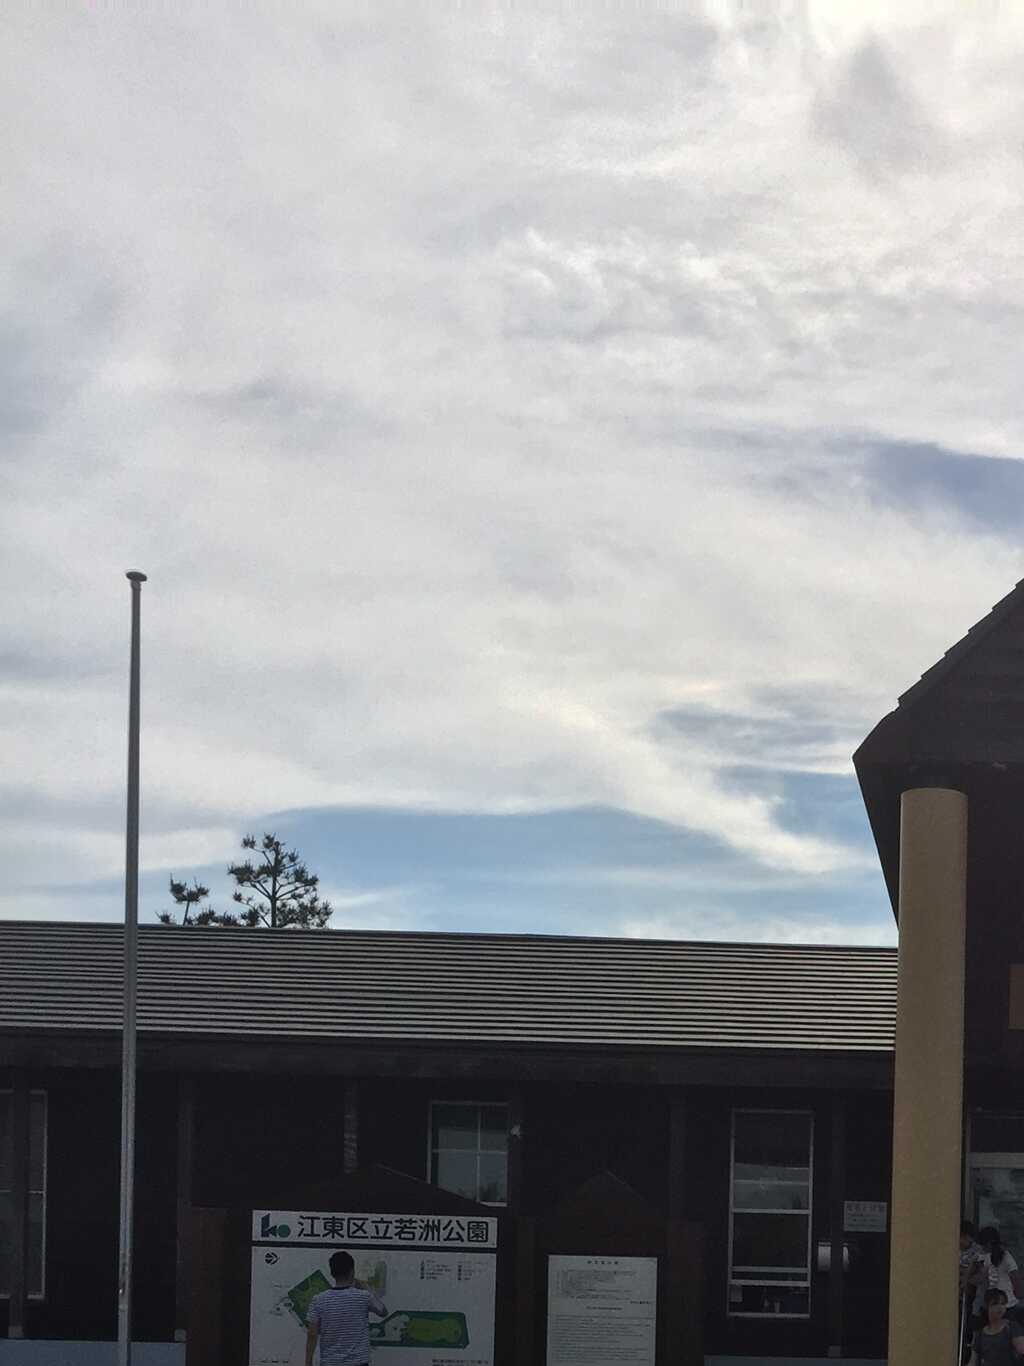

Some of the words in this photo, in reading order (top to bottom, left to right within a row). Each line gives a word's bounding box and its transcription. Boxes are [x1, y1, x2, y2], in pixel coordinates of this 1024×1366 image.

[297, 1215, 489, 1243] 江東区立若洲公園
